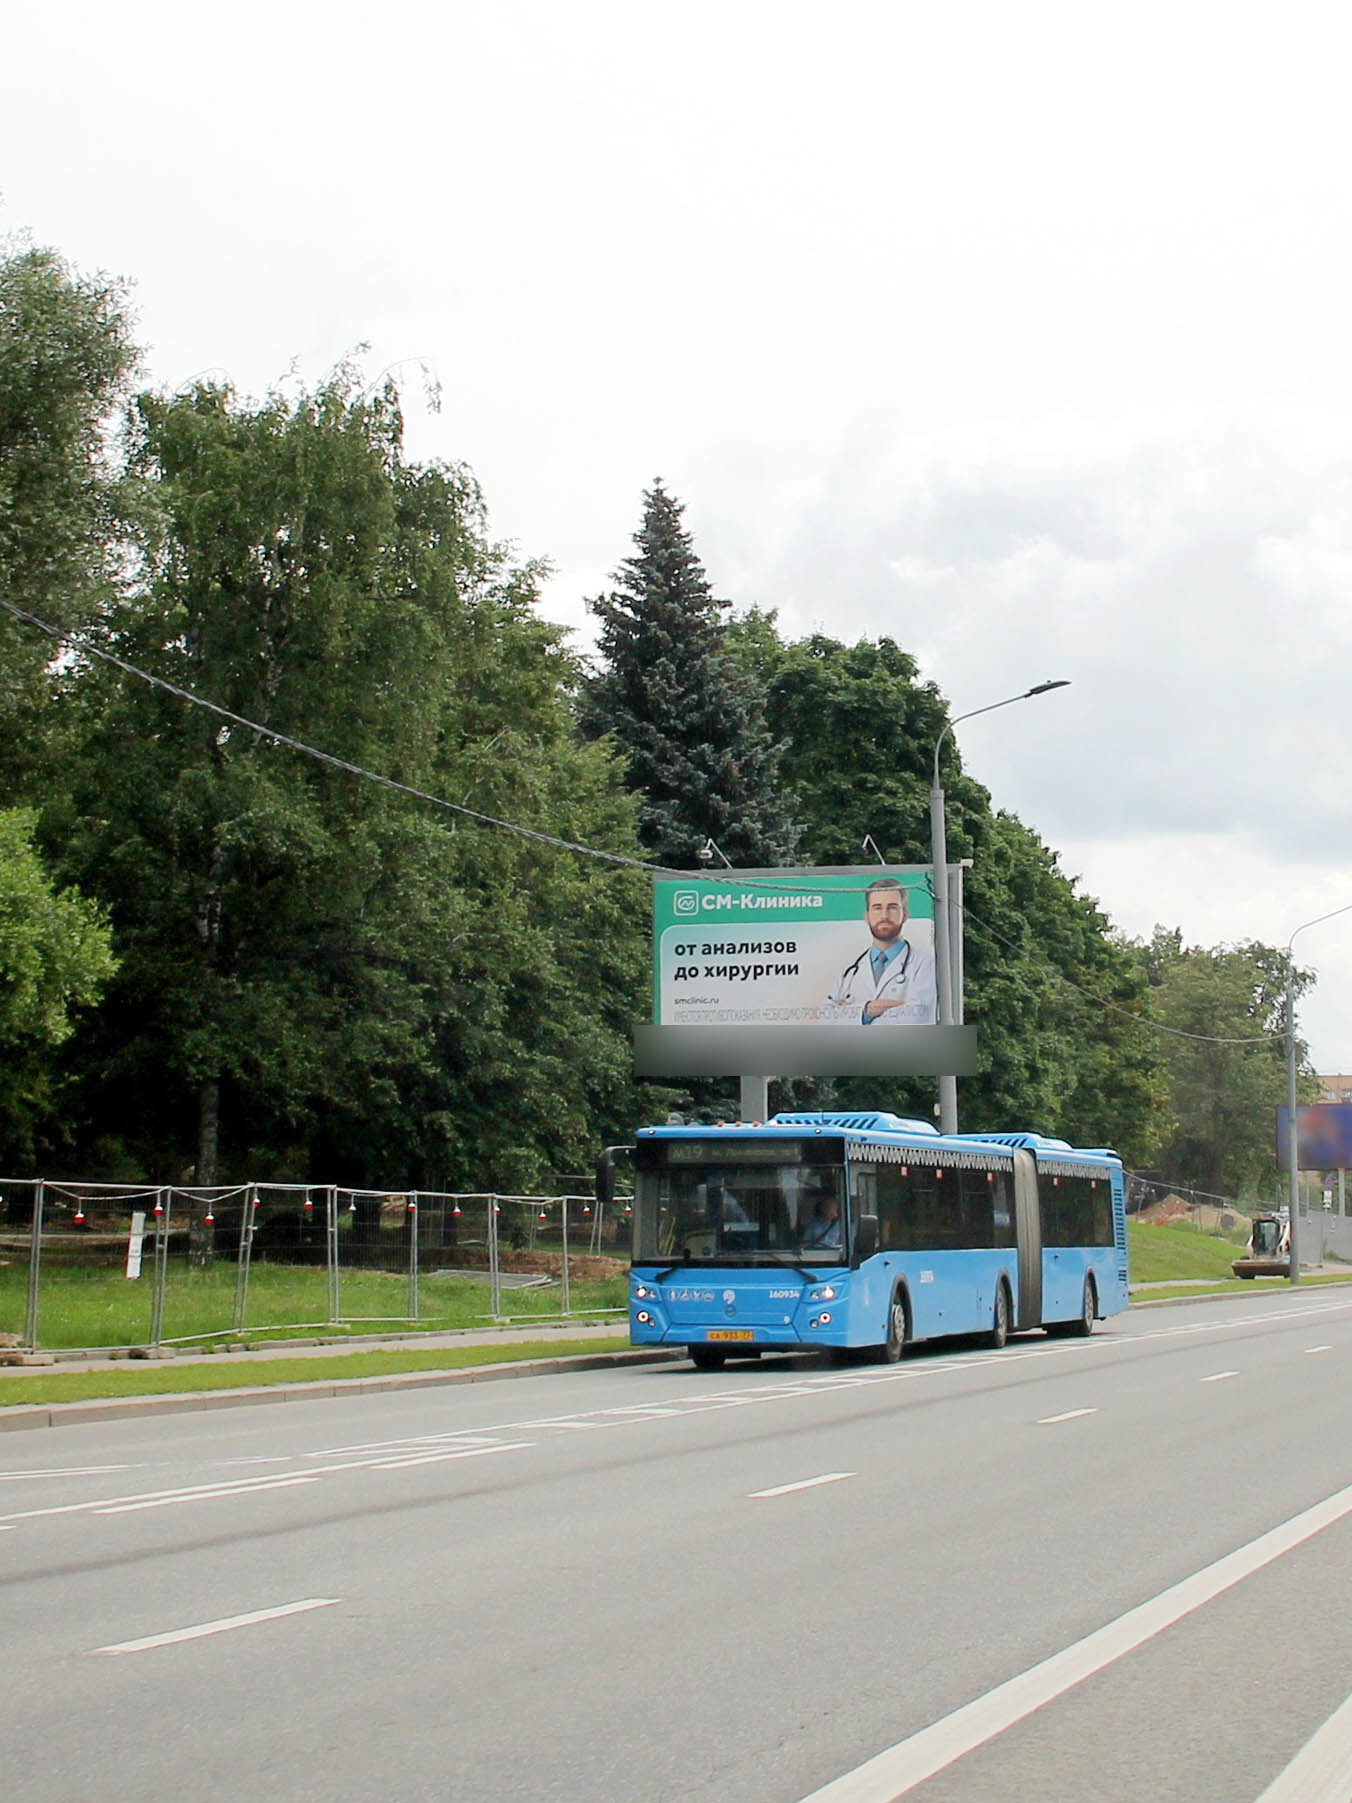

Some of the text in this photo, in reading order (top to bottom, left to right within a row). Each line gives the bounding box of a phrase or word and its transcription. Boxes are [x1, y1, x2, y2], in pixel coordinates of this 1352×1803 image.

[701, 893, 823, 911] СМ-Клиника
[674, 940, 798, 957] от анализов
[674, 962, 800, 981] до хирургии
